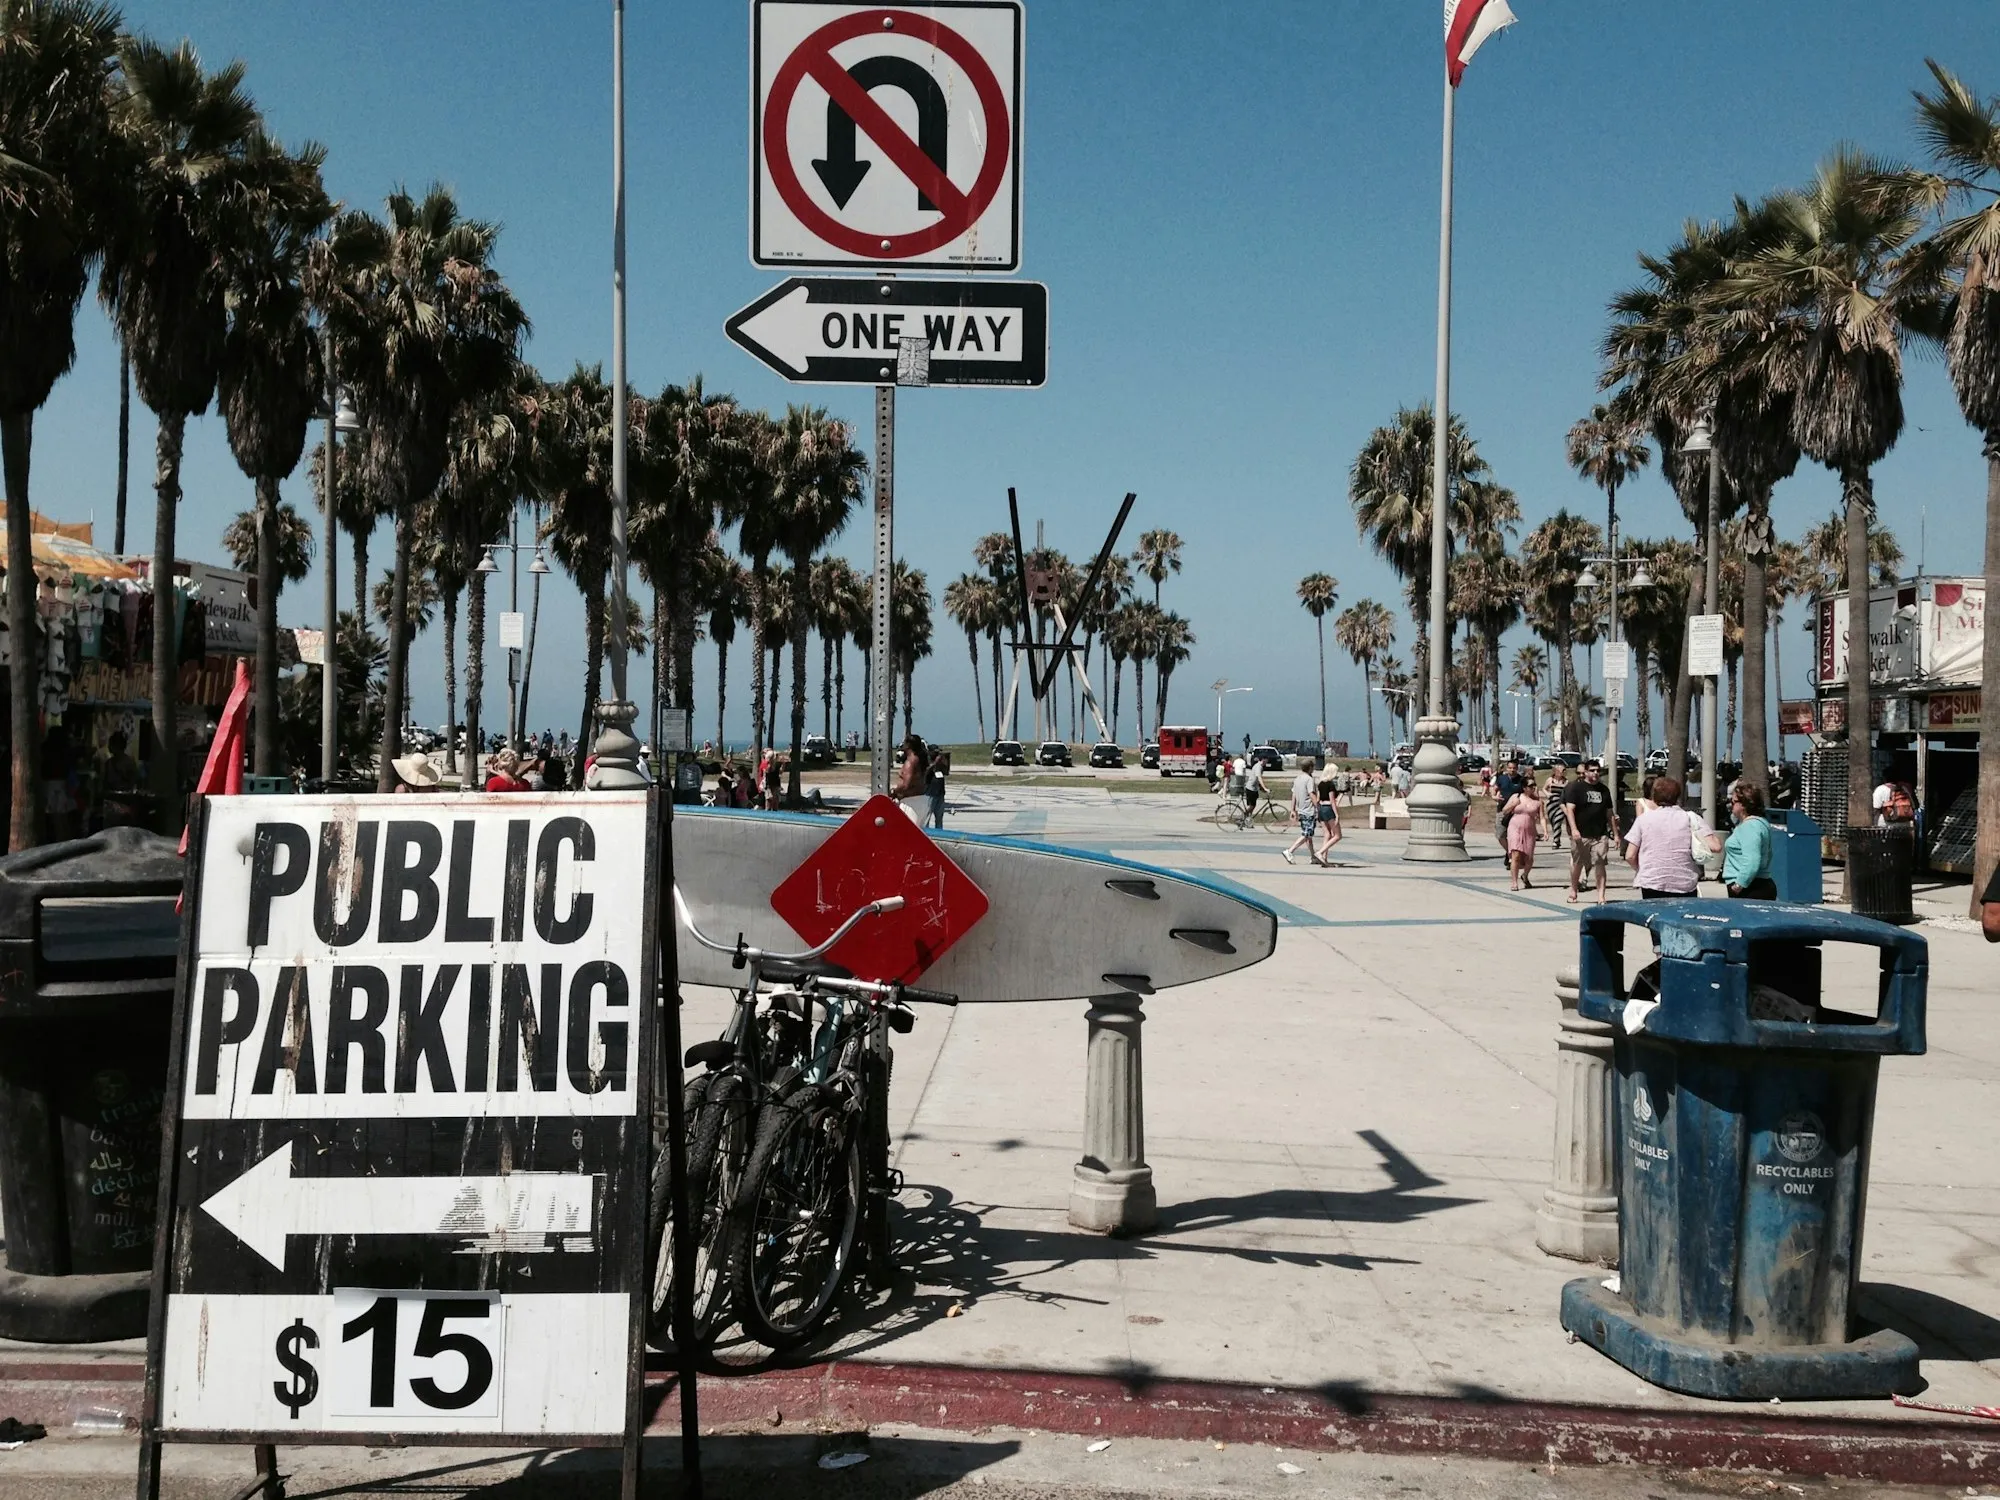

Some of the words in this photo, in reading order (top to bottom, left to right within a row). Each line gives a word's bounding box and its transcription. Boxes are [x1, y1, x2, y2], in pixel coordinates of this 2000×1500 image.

[822, 312, 905, 350] ONE
[924, 315, 1011, 352] WAY
[201, 596, 251, 622] idewalk
[205, 622, 242, 643] arket
[1823, 605, 1832, 673] VENICE
[1842, 623, 1903, 651] Swalk
[246, 816, 596, 947] PUBLIC
[195, 959, 630, 1096] PARKING
[1634, 1156, 1651, 1172] ONLY
[1756, 1164, 1834, 1178] RECYCLABLES
[1783, 1182, 1815, 1195] ONLY
